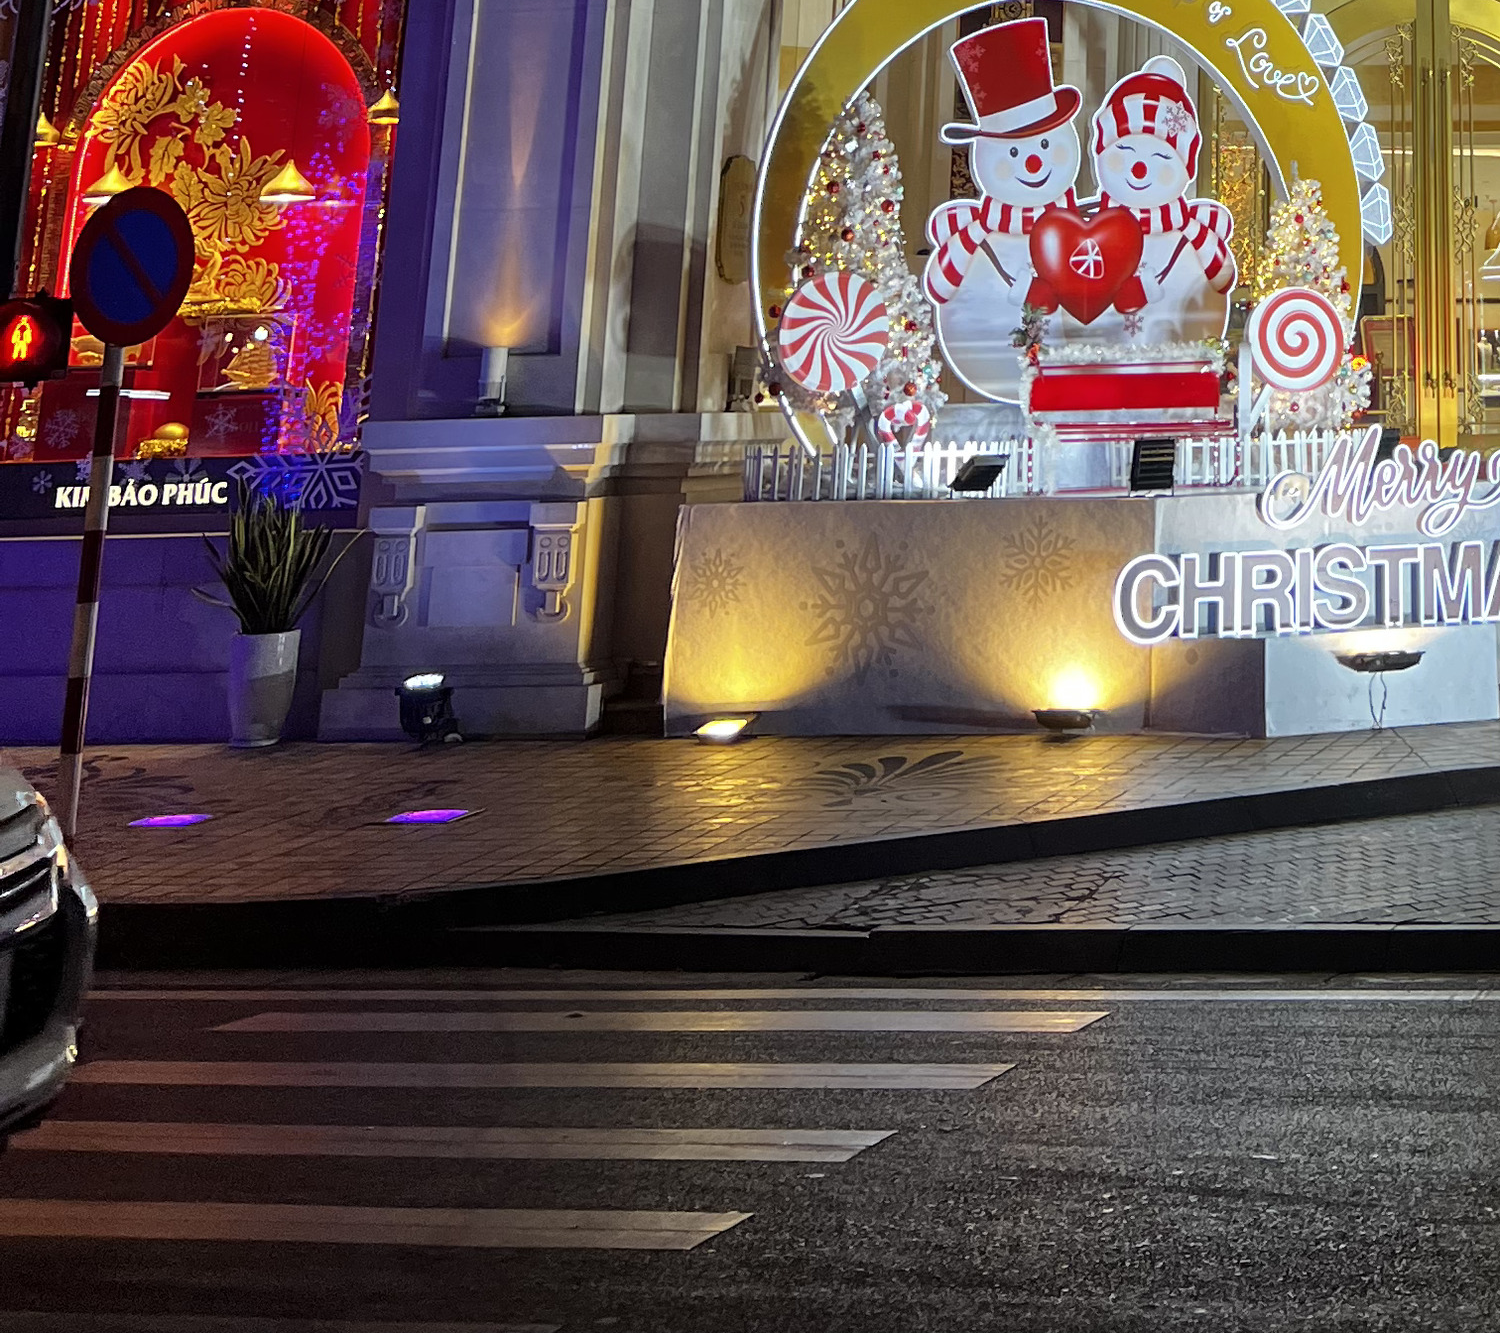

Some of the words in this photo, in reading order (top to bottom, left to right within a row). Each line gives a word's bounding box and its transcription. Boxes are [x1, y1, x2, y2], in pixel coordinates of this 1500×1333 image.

[1207, 0, 1232, 25] of
[1225, 27, 1314, 103] Love
[107, 477, 159, 507] BẢO
[161, 477, 228, 506] PHÚC
